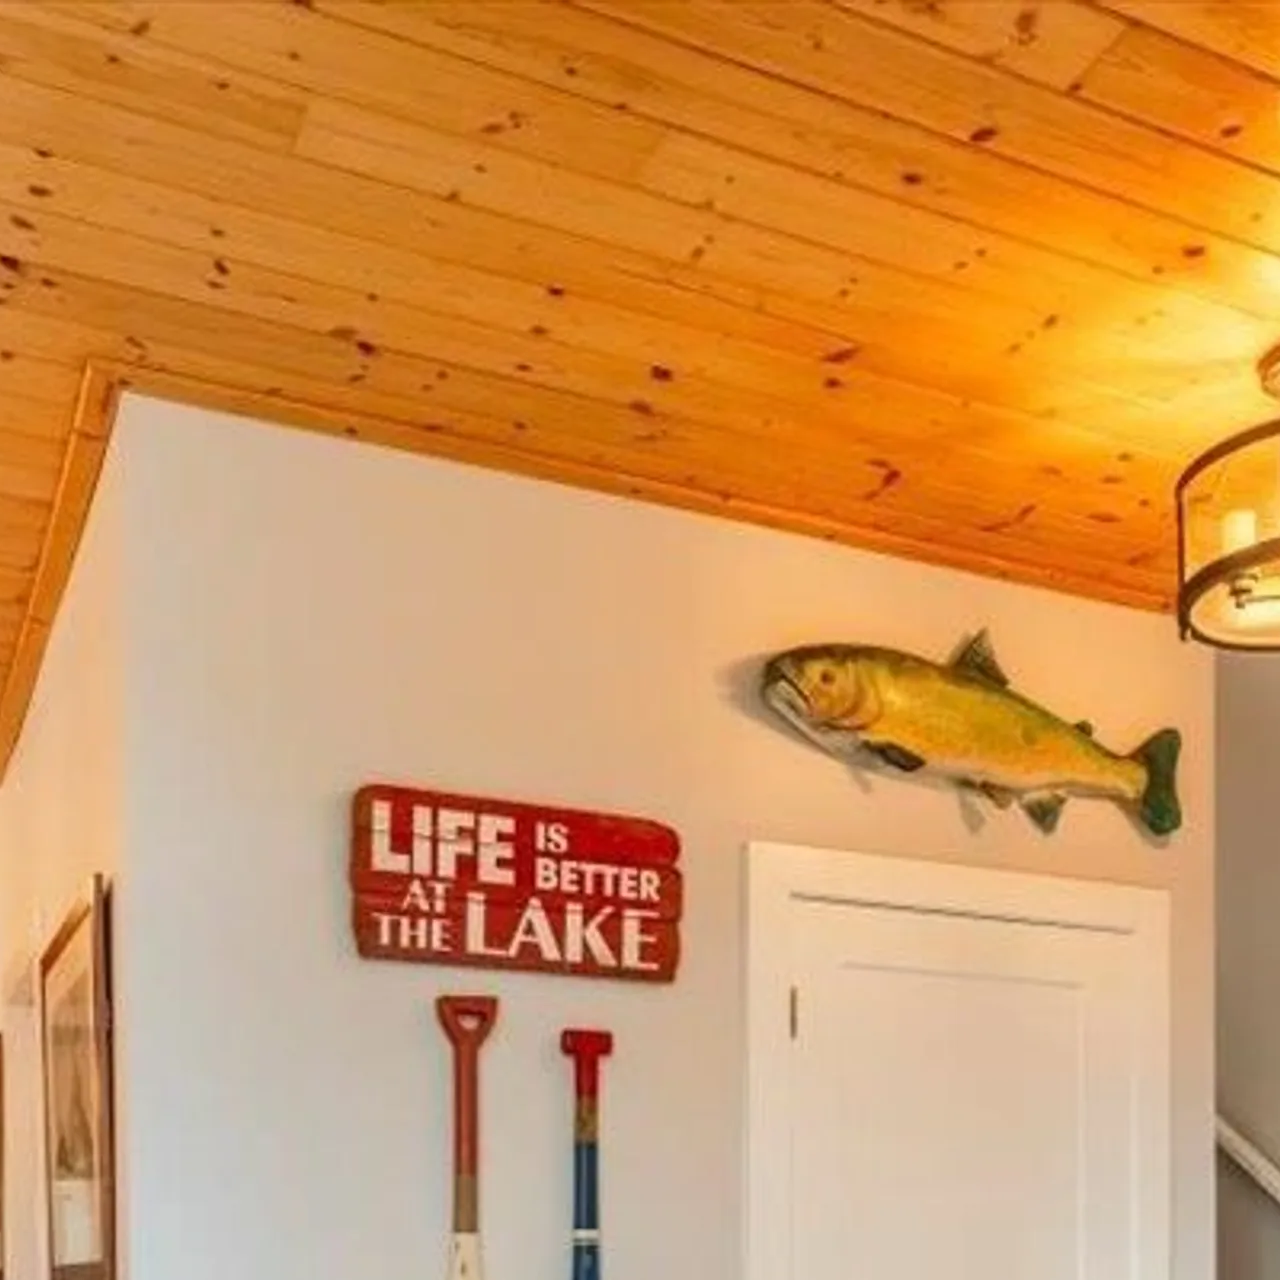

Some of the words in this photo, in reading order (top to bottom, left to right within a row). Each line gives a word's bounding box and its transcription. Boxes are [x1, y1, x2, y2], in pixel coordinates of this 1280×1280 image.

[371, 799, 516, 885] LIFE
[534, 821, 569, 853] IS
[402, 878, 453, 914] AT
[535, 856, 660, 902] BETTER
[371, 910, 454, 952] THE
[466, 890, 660, 970] LAKE
